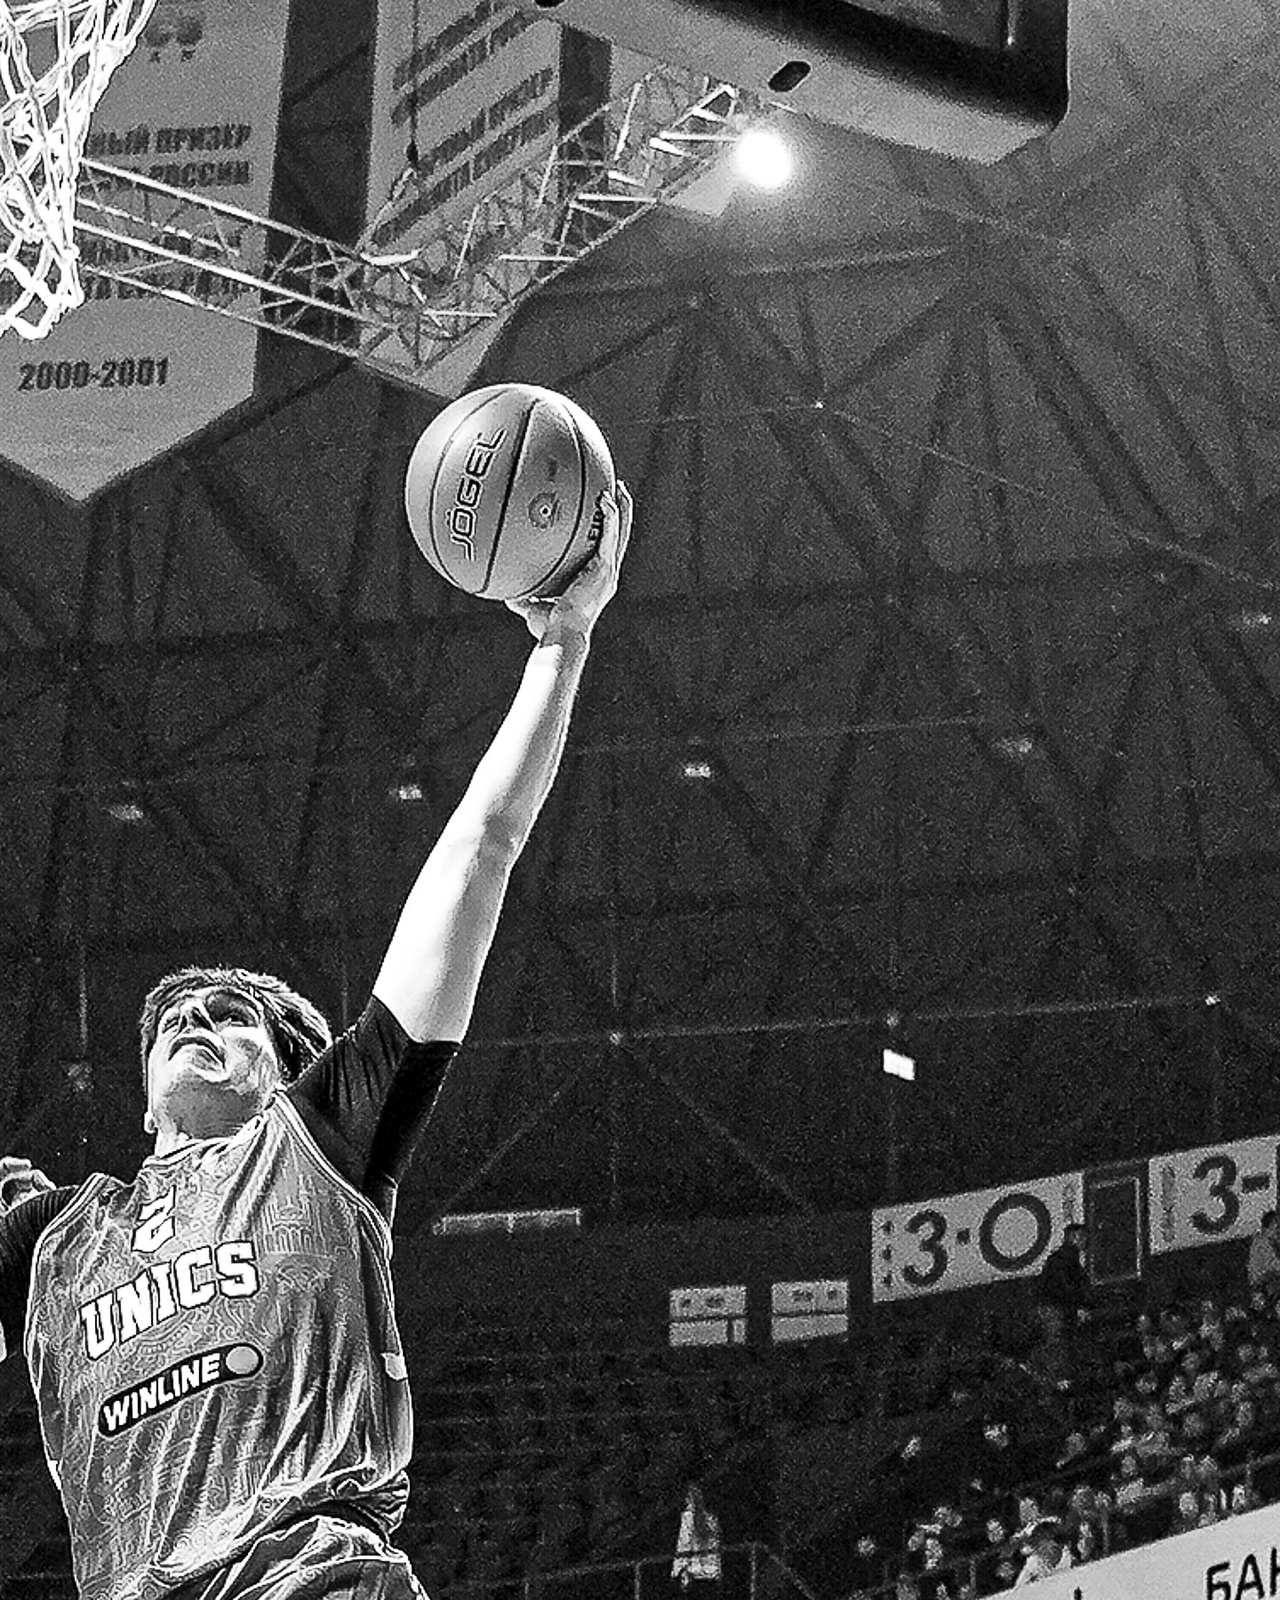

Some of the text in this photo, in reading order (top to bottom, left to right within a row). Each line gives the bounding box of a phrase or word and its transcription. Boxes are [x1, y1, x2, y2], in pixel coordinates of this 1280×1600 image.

[18, 356, 168, 391] 2000-2001
[131, 1186, 176, 1253] 2
[79, 1240, 259, 1361] UNICS
[103, 1352, 221, 1431] WINLINE
